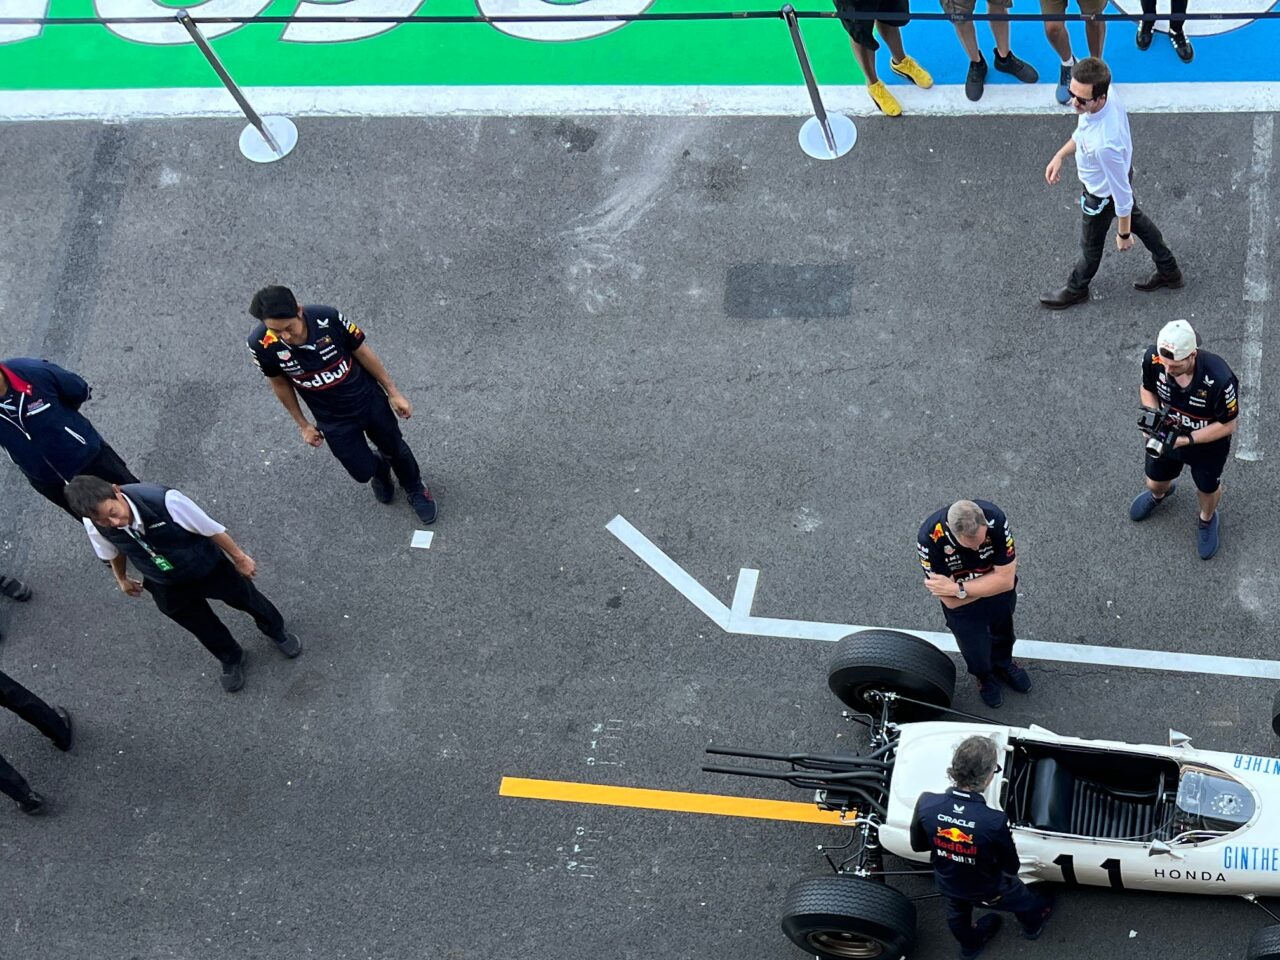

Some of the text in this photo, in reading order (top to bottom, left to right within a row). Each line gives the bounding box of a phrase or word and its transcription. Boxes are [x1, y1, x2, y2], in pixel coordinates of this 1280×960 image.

[321, 360, 350, 384] Bull
[937, 814, 976, 829] ORACLE
[934, 837, 977, 855] Red Bull
[1052, 854, 1125, 889] 11
[1154, 869, 1227, 882] HONDA
